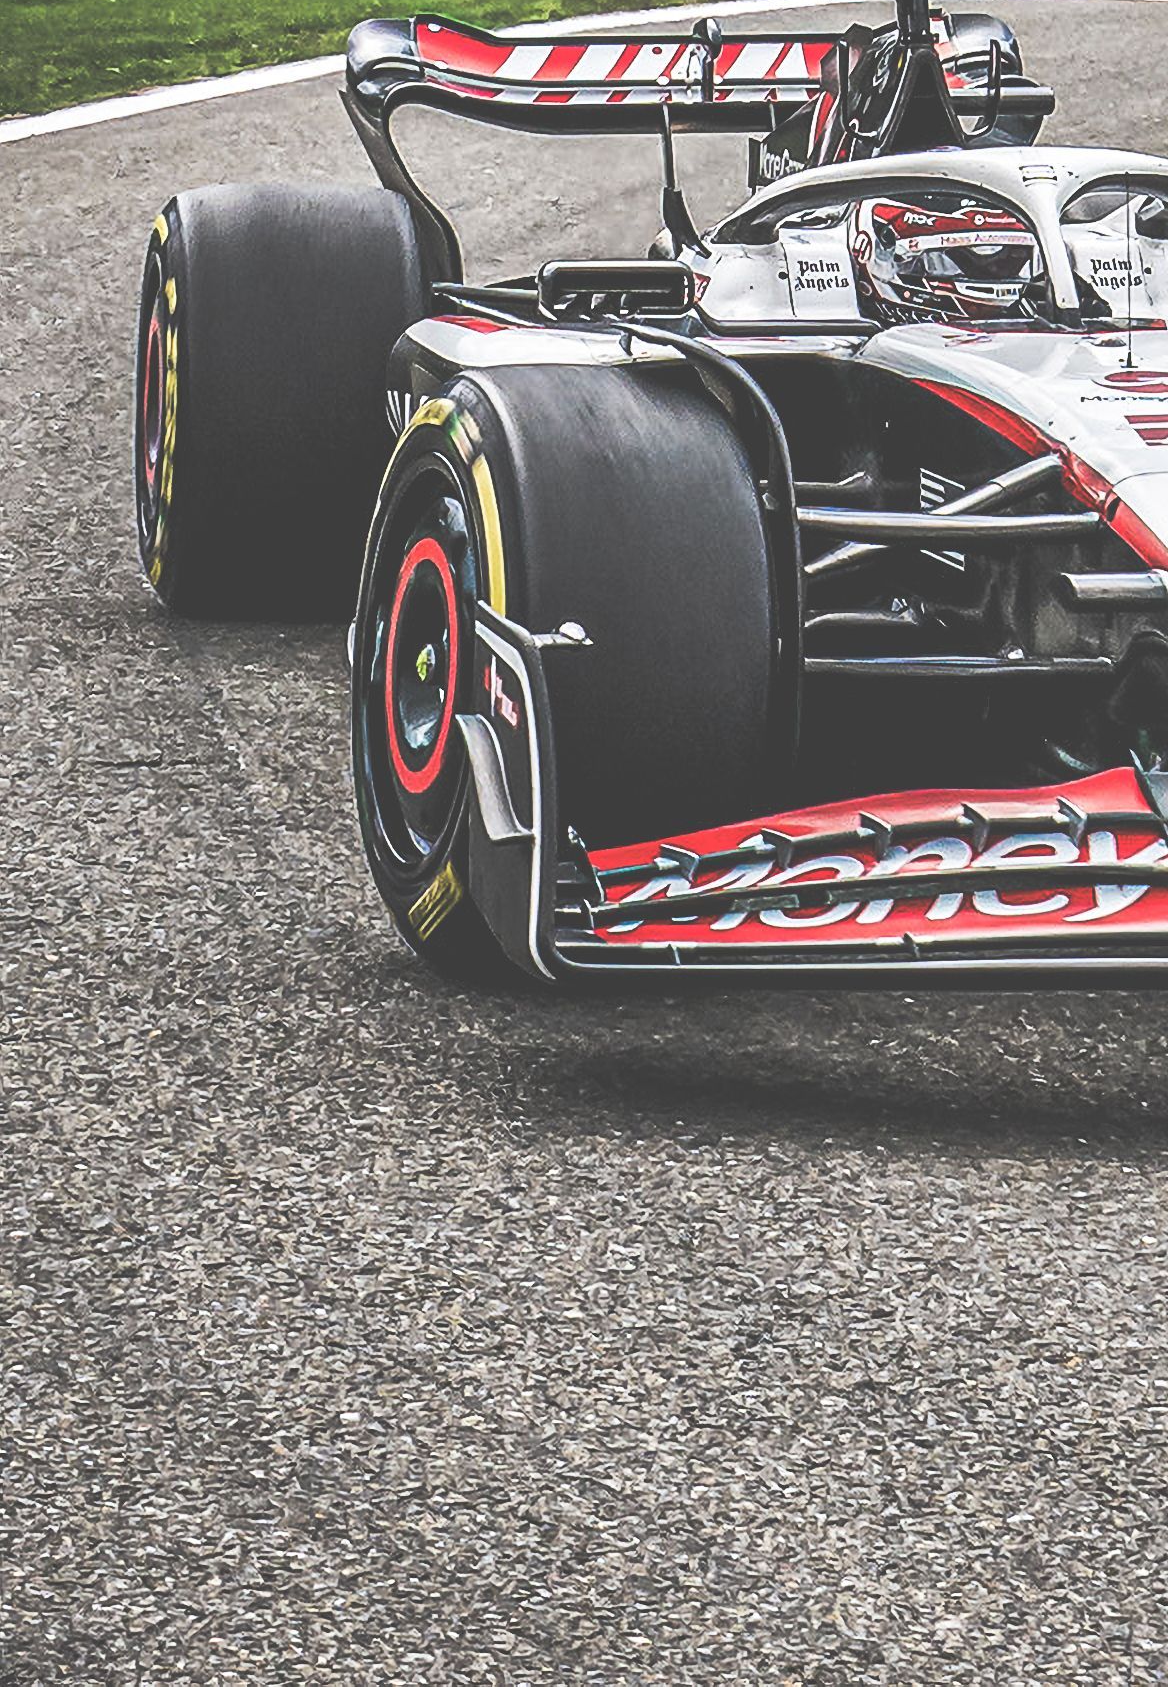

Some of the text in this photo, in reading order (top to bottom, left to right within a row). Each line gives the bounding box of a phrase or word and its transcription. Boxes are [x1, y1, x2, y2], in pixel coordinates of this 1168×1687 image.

[797, 259, 840, 276] Palm
[1090, 257, 1133, 275] Palm
[794, 275, 850, 292] Angels
[1090, 274, 1143, 291] Angels
[607, 829, 1168, 933] Money
